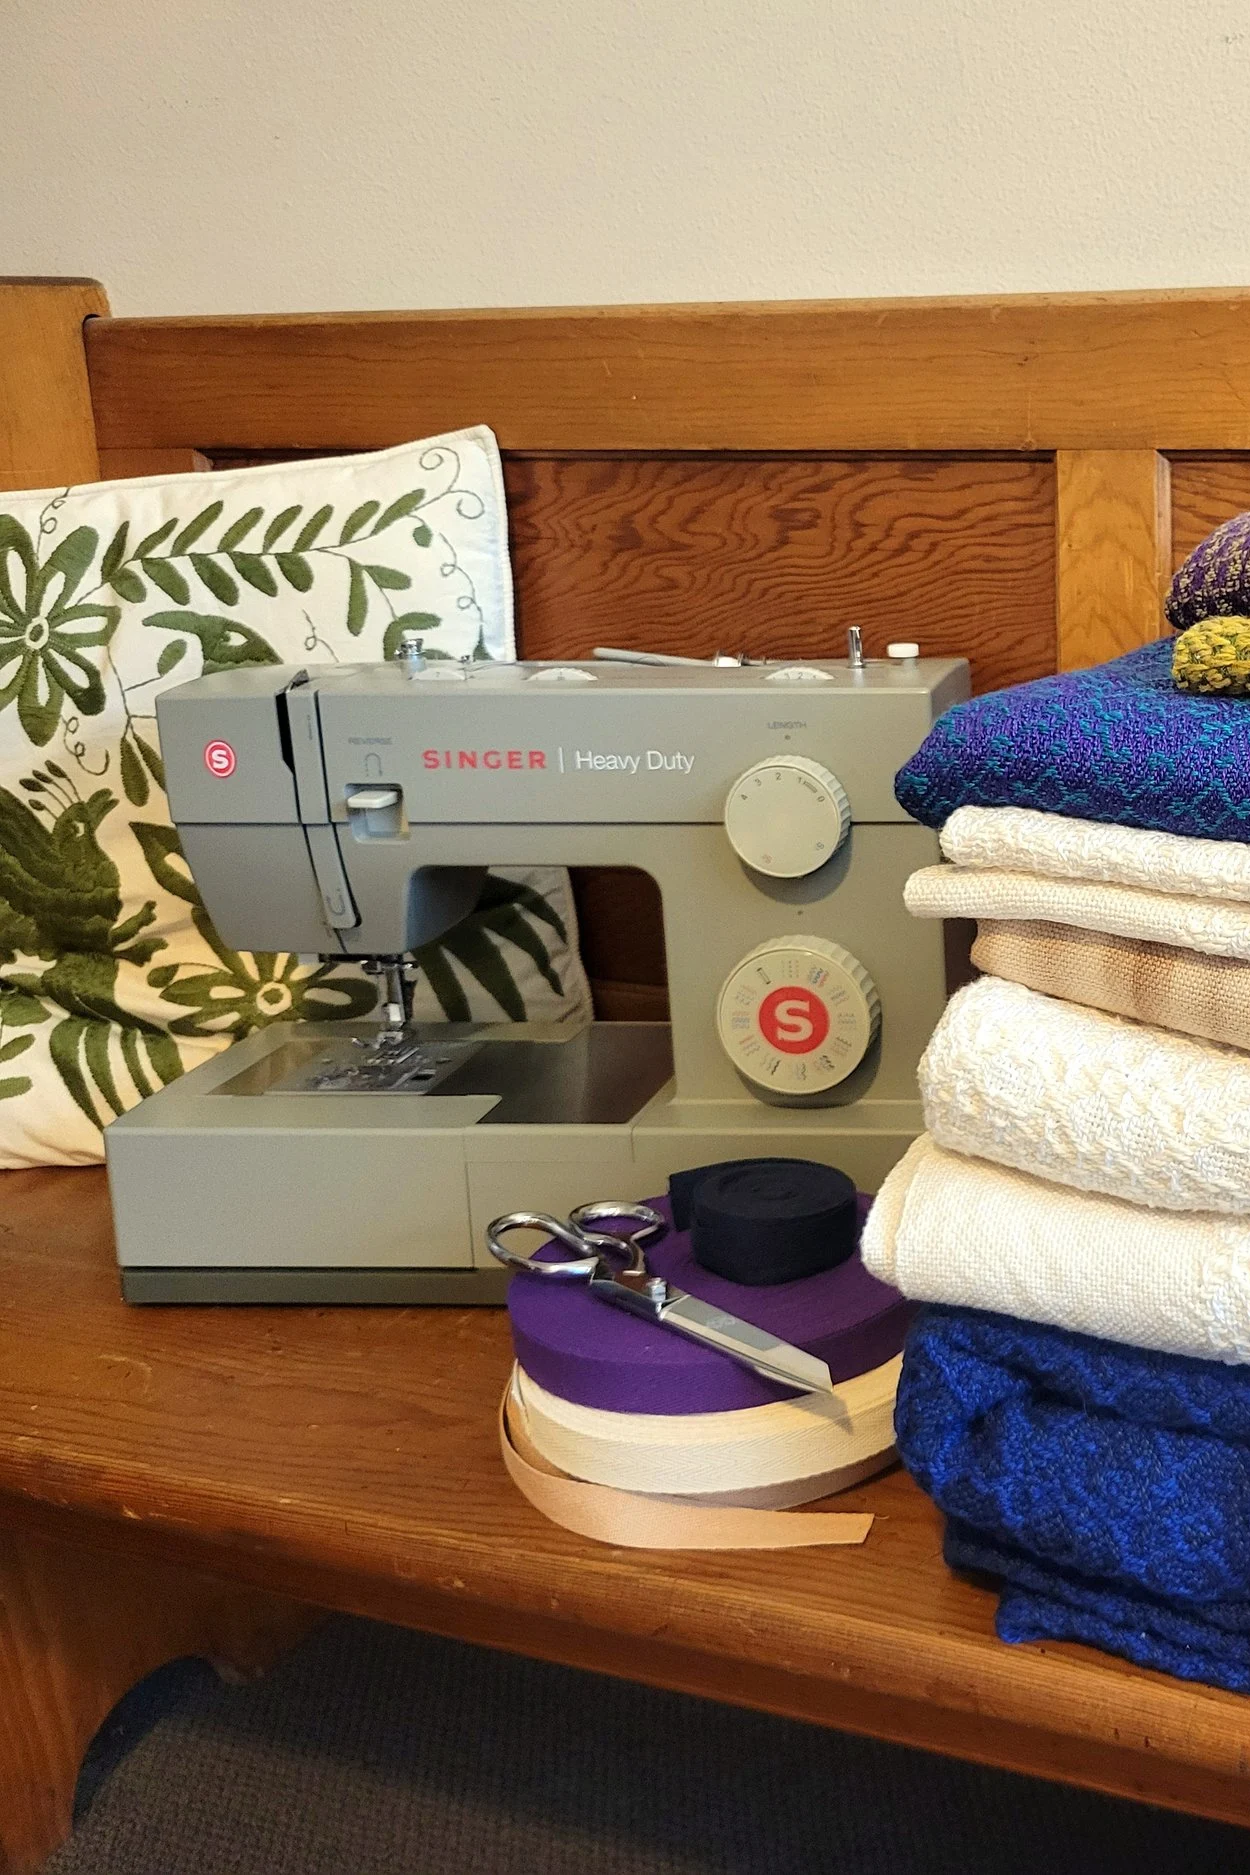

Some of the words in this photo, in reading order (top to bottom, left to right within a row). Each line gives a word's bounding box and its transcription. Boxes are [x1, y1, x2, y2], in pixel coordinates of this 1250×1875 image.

[767, 720, 808, 730] LENGTH
[211, 749, 229, 770] S
[422, 749, 547, 770] SINGER
[575, 750, 641, 775] Heavy
[647, 749, 696, 775] Duty
[775, 772, 782, 781] 2
[774, 999, 814, 1043] S
